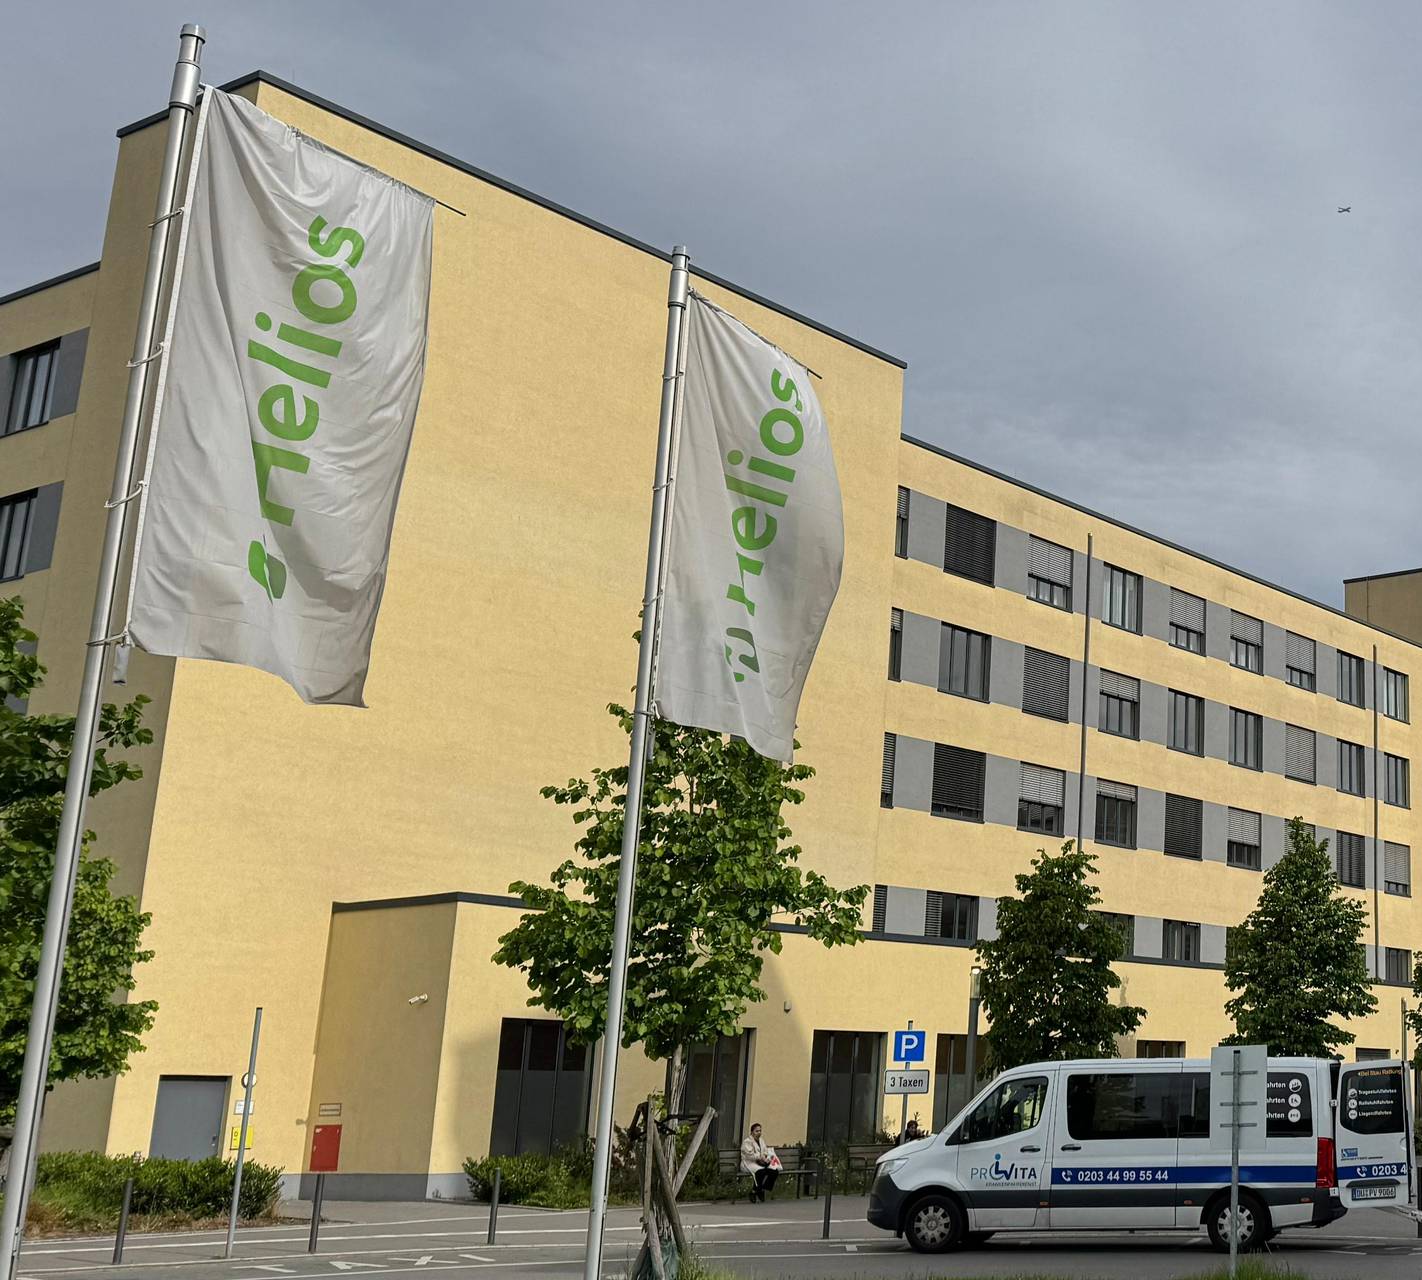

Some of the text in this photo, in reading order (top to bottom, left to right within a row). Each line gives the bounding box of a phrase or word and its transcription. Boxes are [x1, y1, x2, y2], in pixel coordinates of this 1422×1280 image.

[890, 1076, 924, 1087] 3 Taxen
[1077, 1170, 1168, 1181] 0203 44 99 55 44
[1372, 1165, 1397, 1176] 0203
